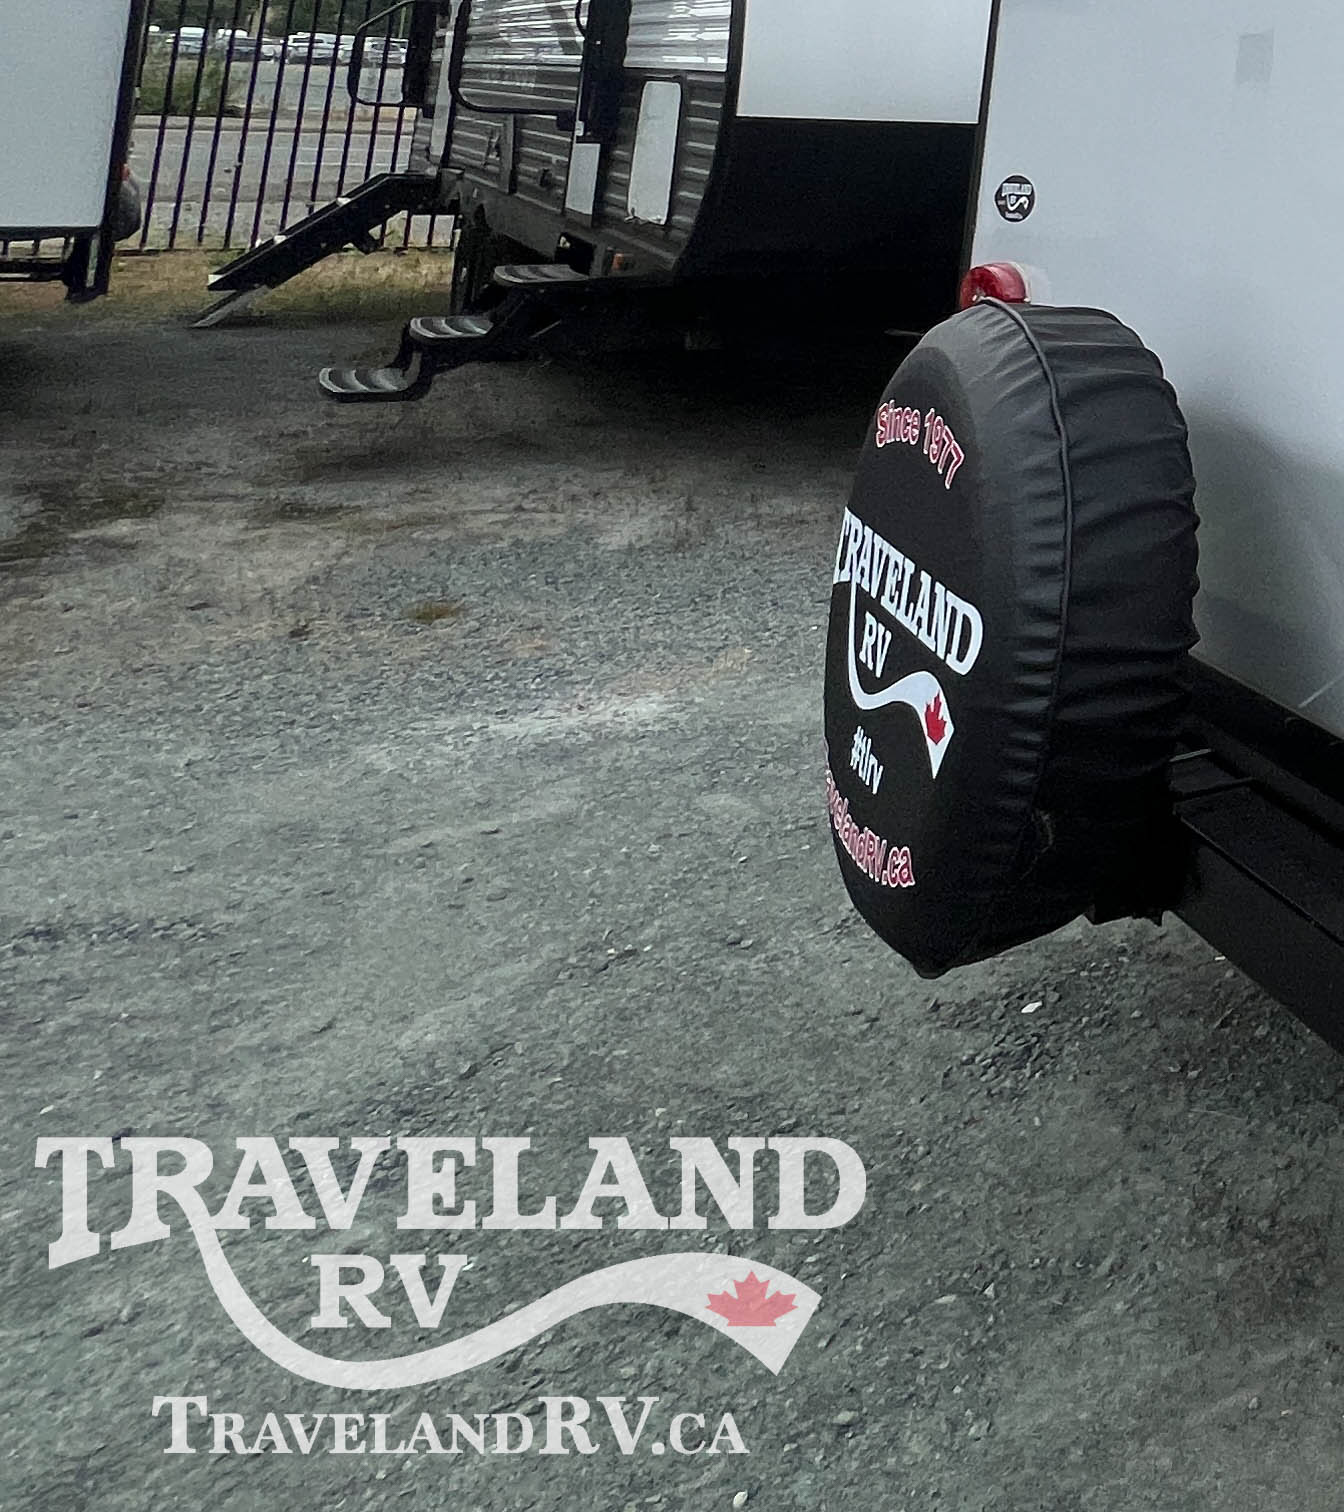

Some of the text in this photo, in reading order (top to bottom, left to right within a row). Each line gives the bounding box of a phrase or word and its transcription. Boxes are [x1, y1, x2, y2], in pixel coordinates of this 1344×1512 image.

[876, 399, 965, 490] Since 1977
[858, 611, 892, 678] RV
